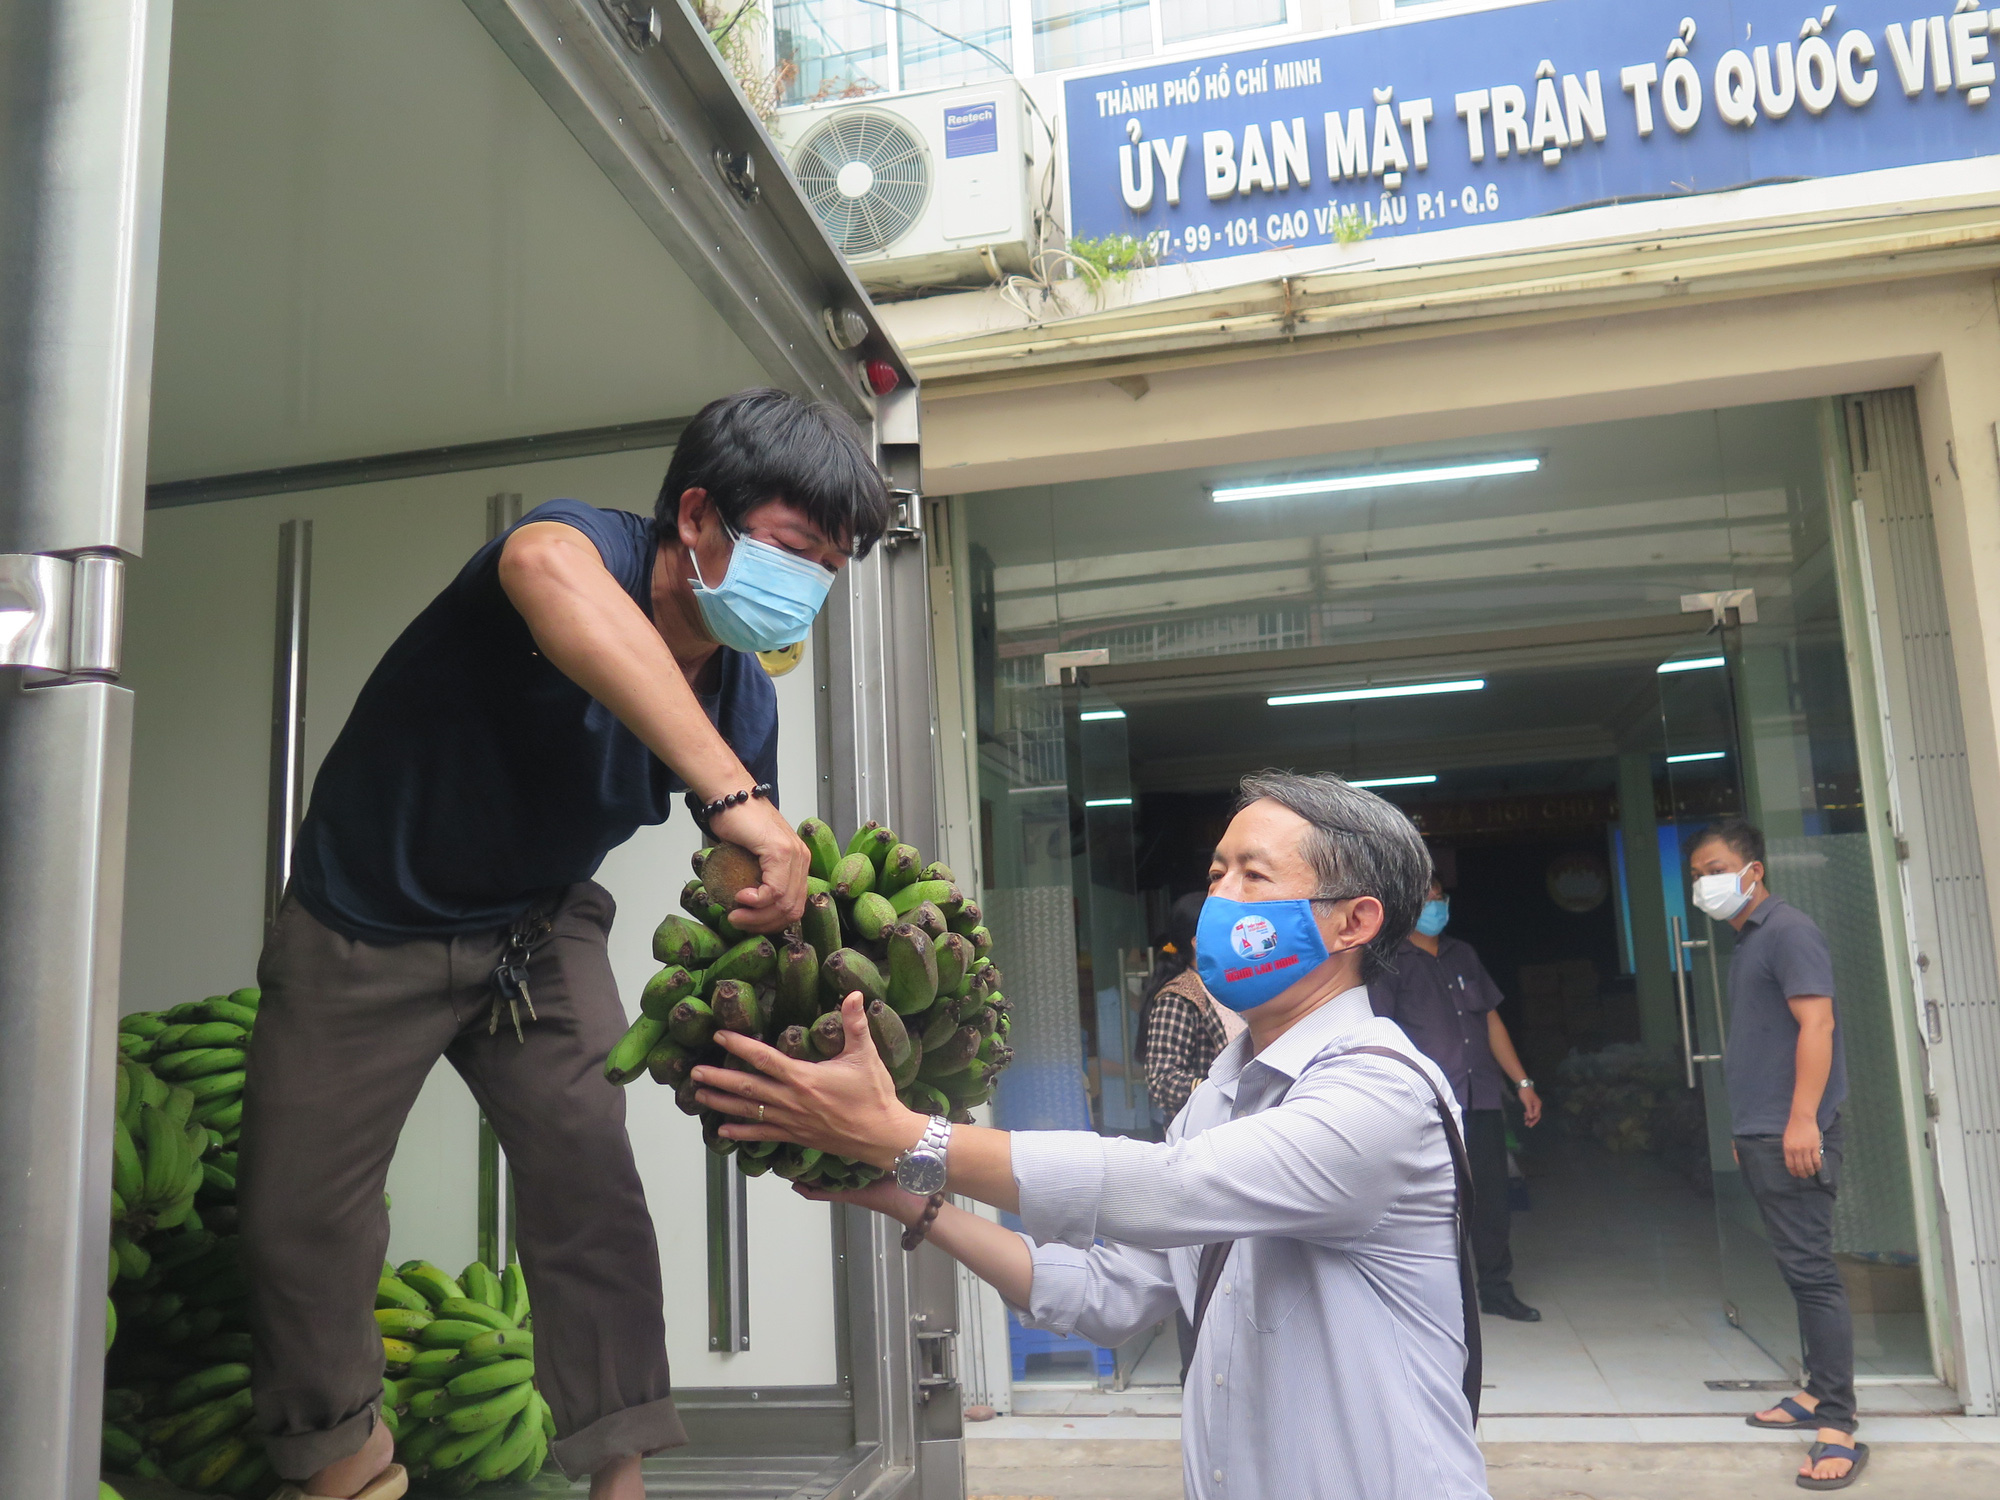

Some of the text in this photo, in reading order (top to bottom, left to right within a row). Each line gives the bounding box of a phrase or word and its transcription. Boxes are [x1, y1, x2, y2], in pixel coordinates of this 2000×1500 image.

[1095, 58, 1322, 117] THÀNH PHỐ HỒ CHÍ MINH
[1119, 117, 1188, 211] ỦY
[1203, 116, 1311, 200] BAN
[1324, 85, 1434, 189] MẶT
[1455, 59, 1608, 166] TRẬN
[1620, 17, 1703, 134] TỔ
[1714, 4, 1879, 127] QUỐC
[947, 110, 993, 126] Reetech
[1266, 209, 1309, 242] CAO
